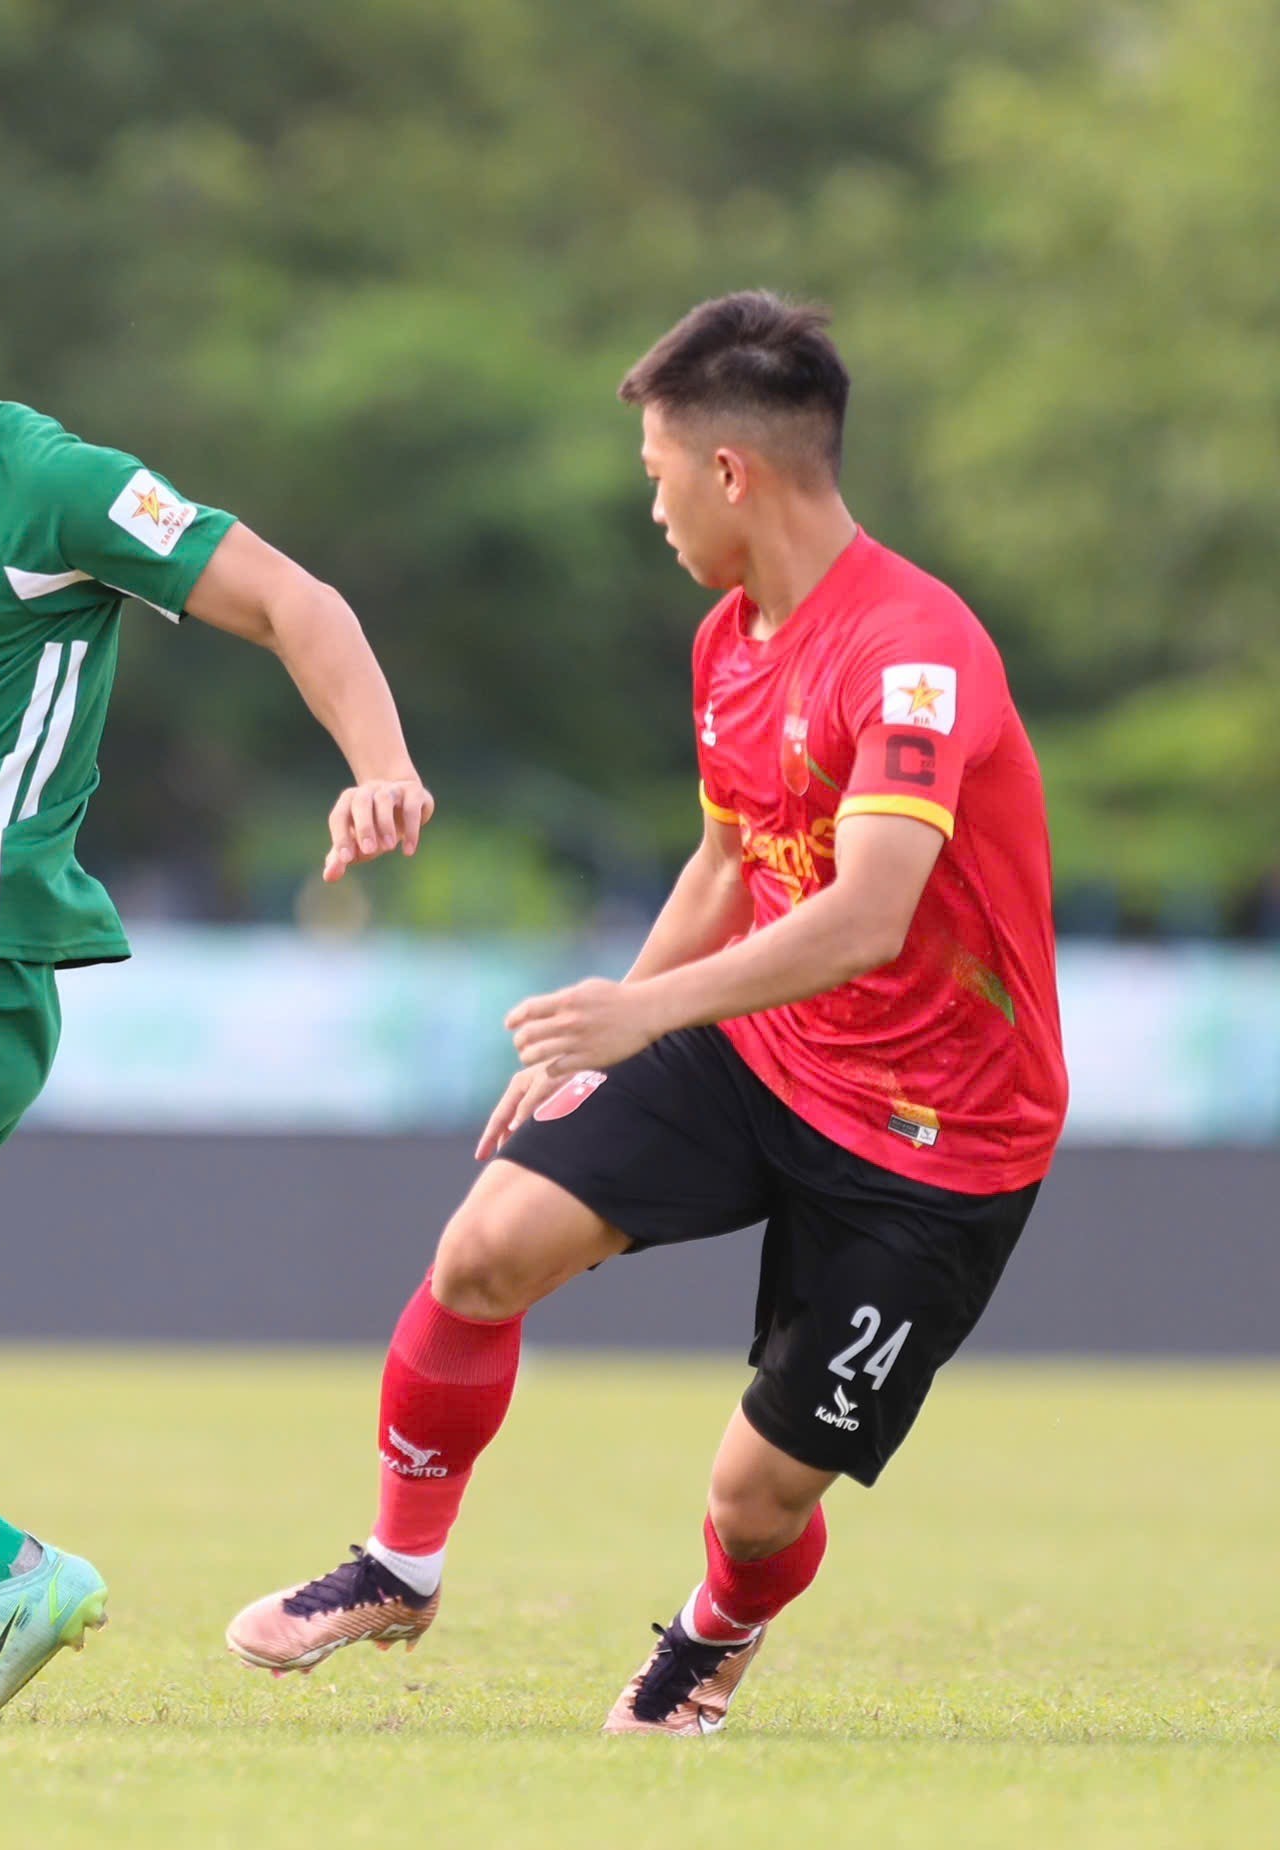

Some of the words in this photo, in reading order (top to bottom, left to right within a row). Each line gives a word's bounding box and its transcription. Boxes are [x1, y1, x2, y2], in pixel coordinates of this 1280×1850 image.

[884, 734, 935, 787] C
[827, 1305, 913, 1391] 24
[815, 1405, 860, 1432] KAMITO
